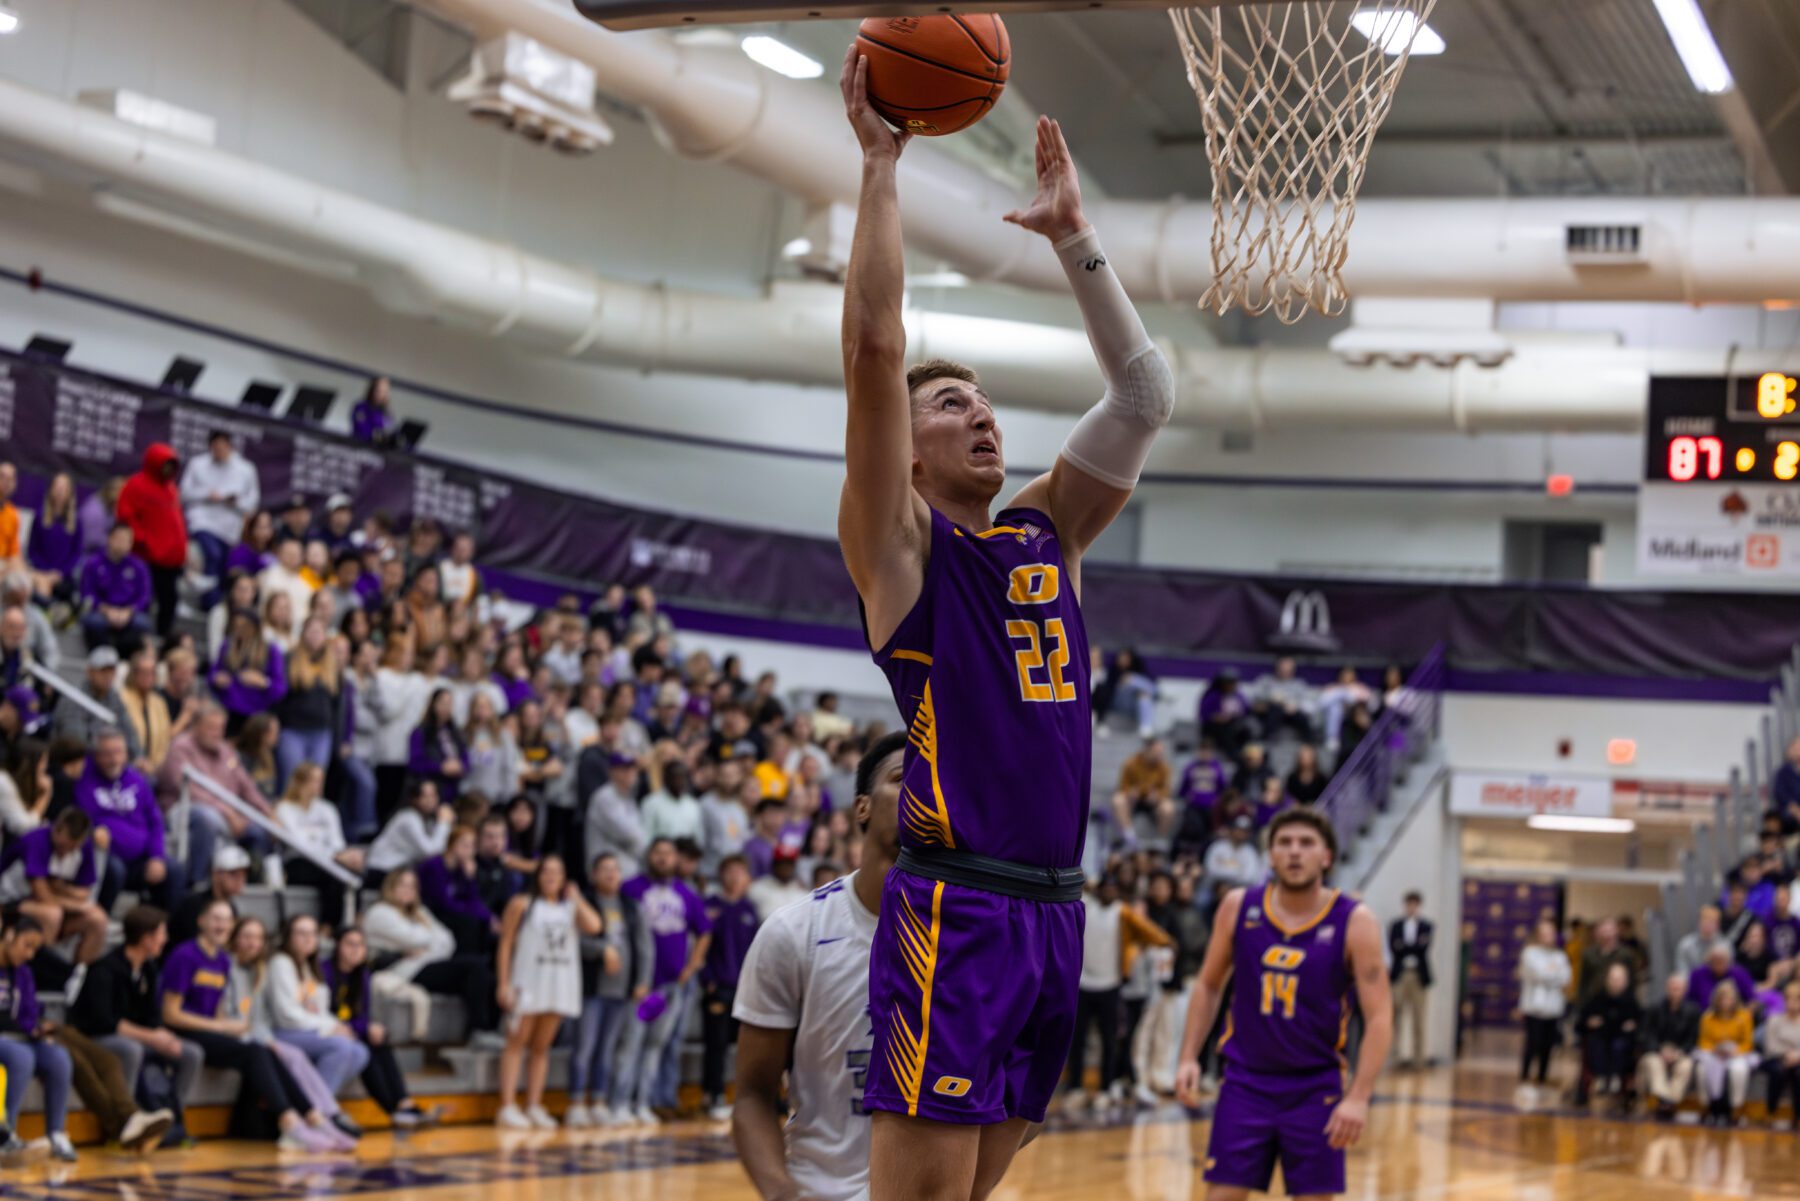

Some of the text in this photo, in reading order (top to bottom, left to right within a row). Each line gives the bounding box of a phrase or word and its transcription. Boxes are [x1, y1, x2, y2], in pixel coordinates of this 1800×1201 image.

[1668, 435, 1722, 481] 87
[1650, 538, 1742, 560] Midland
[1005, 617, 1076, 702] 22
[1480, 782, 1577, 815] meijer
[1260, 971, 1299, 1019] 14
